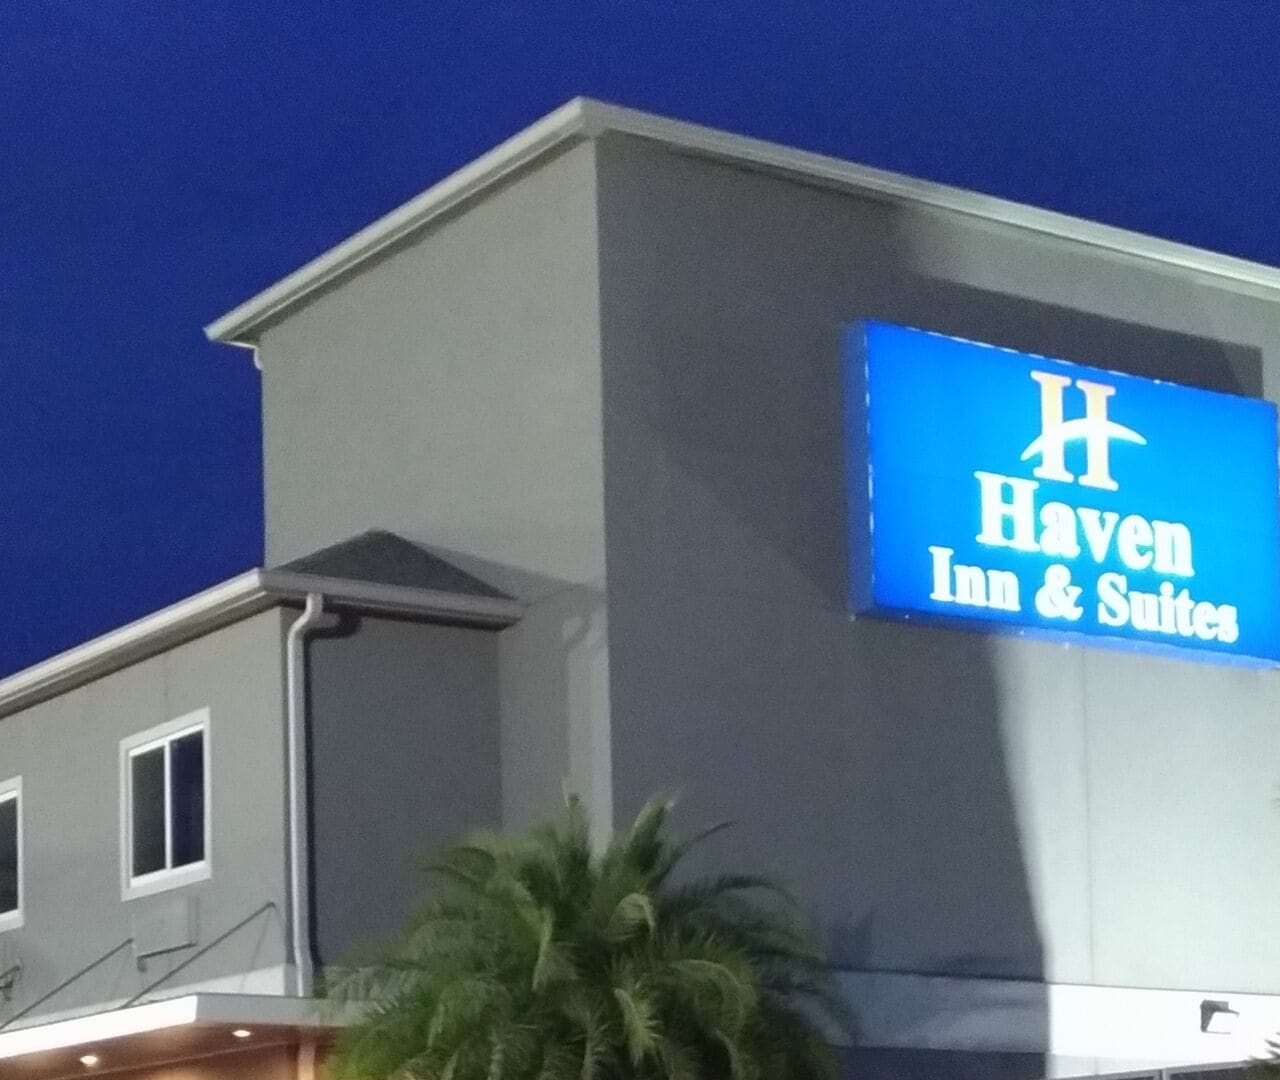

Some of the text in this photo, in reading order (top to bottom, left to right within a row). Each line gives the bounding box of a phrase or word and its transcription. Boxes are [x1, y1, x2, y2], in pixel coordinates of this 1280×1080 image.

[1022, 371, 1147, 490] H
[974, 471, 1194, 576] Haven
[929, 546, 1238, 643] Inn & Suites
